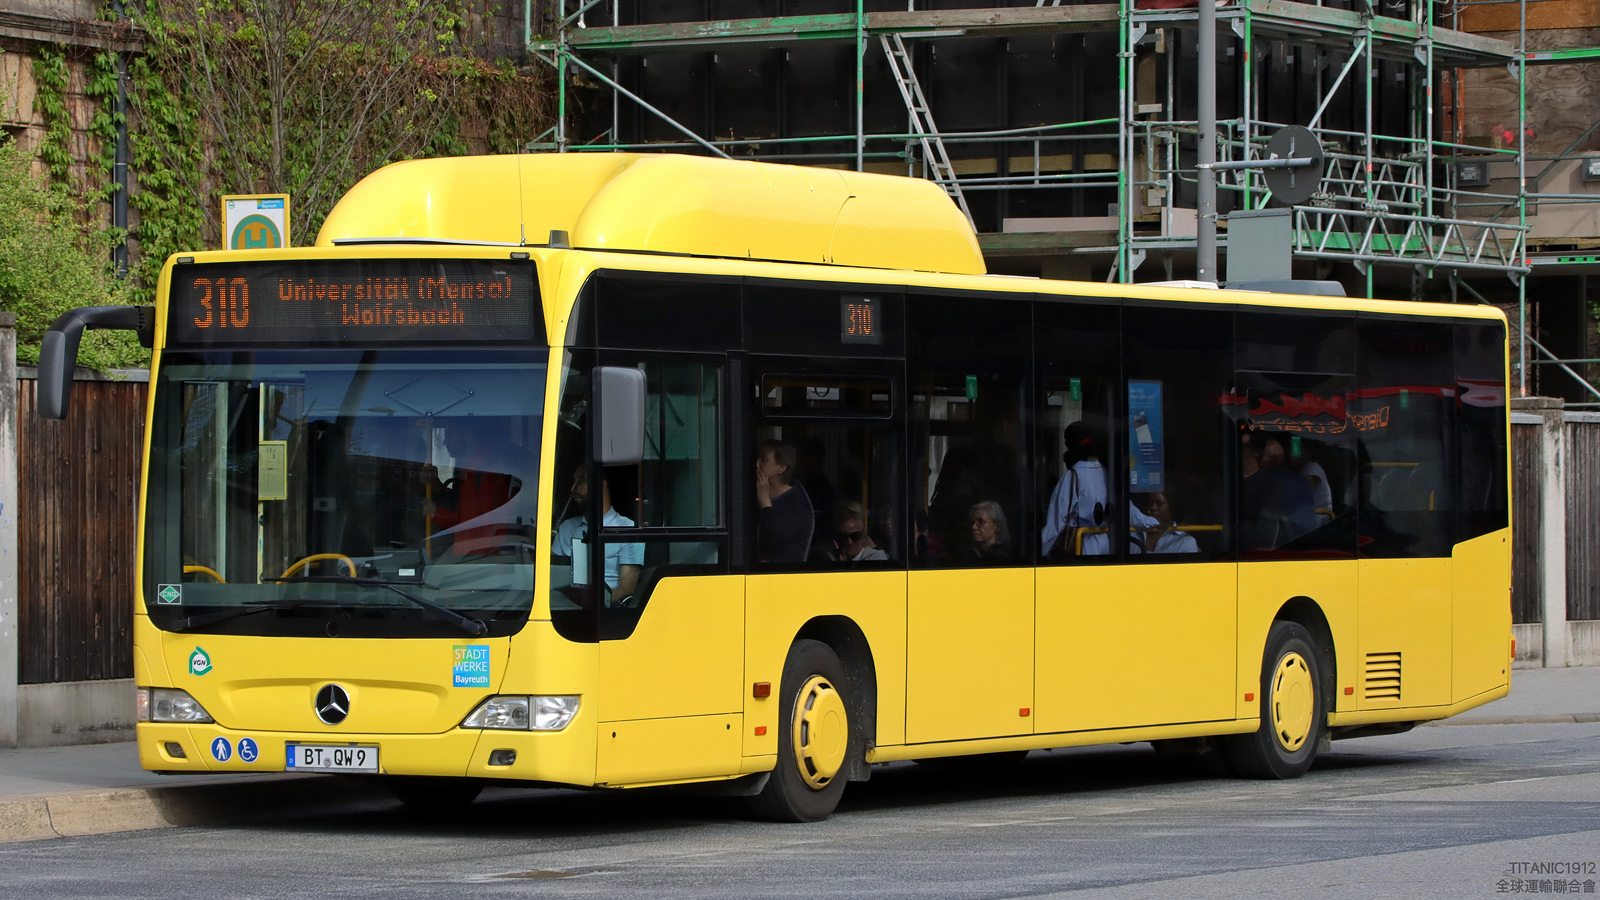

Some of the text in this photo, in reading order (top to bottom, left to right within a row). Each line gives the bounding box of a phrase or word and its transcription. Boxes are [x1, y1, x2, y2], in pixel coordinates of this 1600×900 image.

[193, 277, 249, 328] 310
[418, 276, 511, 299] (Mensa)
[847, 303, 872, 335] 310
[454, 648, 488, 660] STADT
[454, 661, 488, 672] WERKE
[455, 674, 489, 685] Bayreuth
[304, 748, 366, 767] BT QW 9
